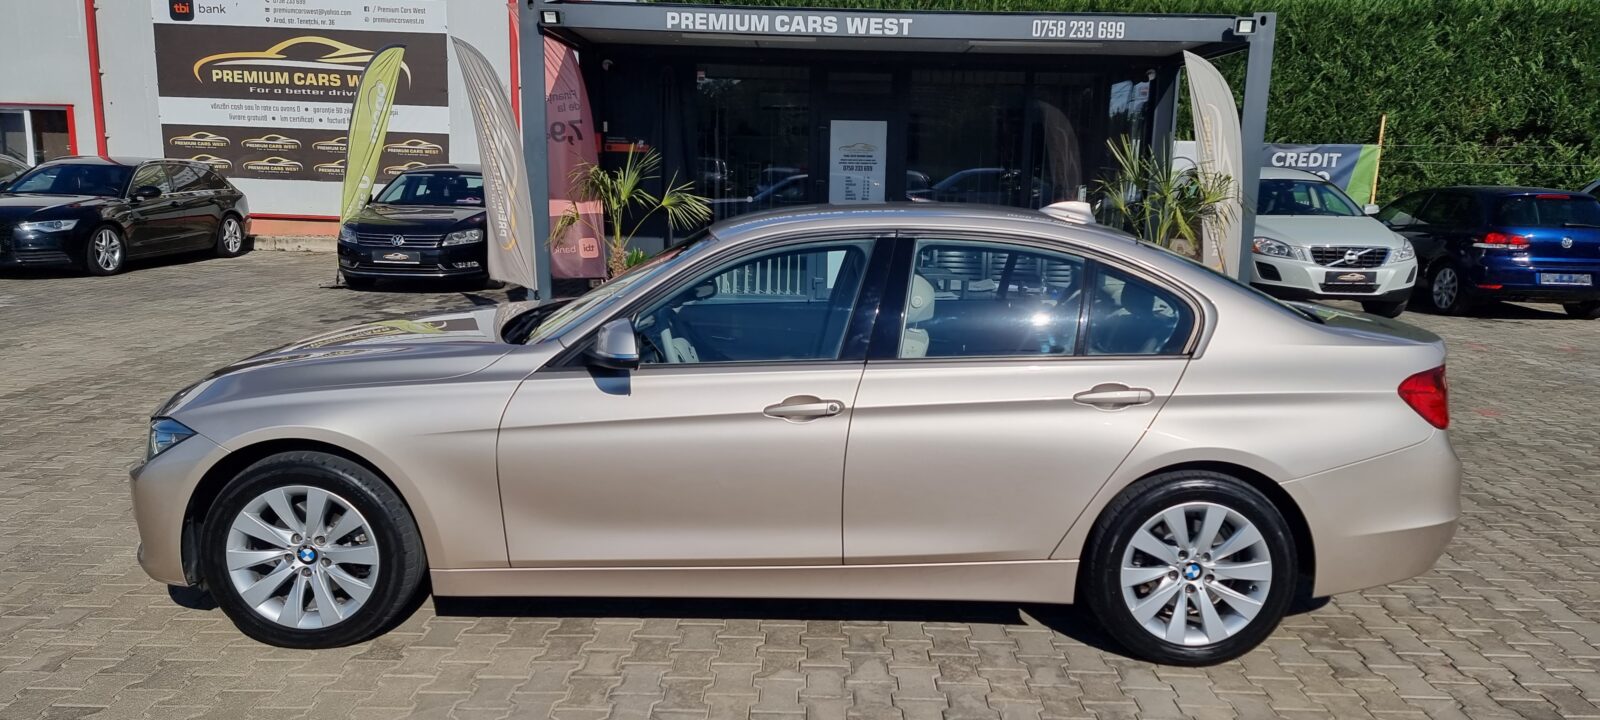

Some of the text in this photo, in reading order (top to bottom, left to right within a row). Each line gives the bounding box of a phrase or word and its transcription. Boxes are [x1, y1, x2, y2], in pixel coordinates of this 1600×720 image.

[174, 3, 226, 14] tbi bank
[666, 12, 913, 35] PREMIUM CARS WEST
[1032, 19, 1125, 39] 0758 233 699
[211, 69, 290, 85] PREMIUM
[293, 72, 341, 87] CARS
[249, 86, 271, 94] For
[285, 87, 324, 96] better
[1271, 151, 1342, 168] CREDIT
